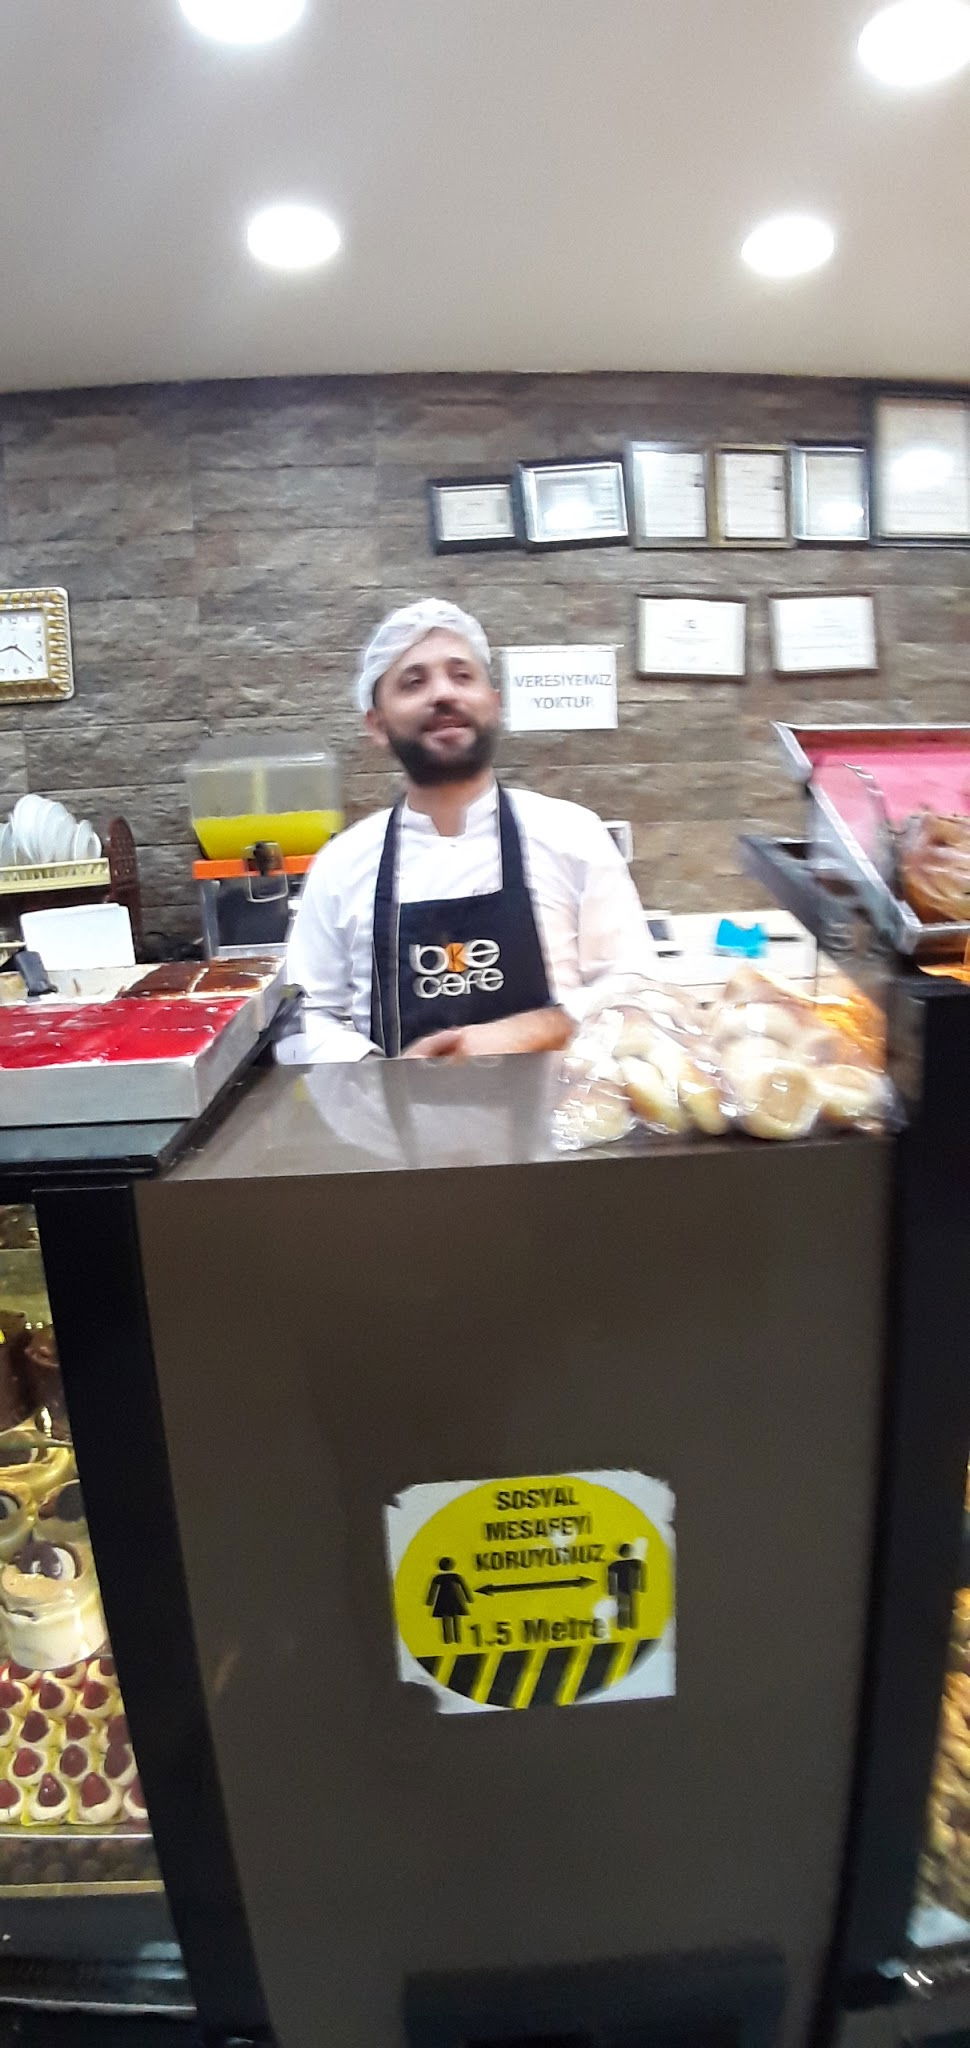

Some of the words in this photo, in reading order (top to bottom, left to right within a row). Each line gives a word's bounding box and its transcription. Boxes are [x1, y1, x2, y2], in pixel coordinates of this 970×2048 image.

[533, 695, 594, 709] YOKTUR
[497, 1486, 579, 1511] SOSYAL
[475, 1544, 606, 1572] KORUYUNUZ
[468, 1620, 513, 1647] 1.5
[522, 1617, 609, 1644] Metre
